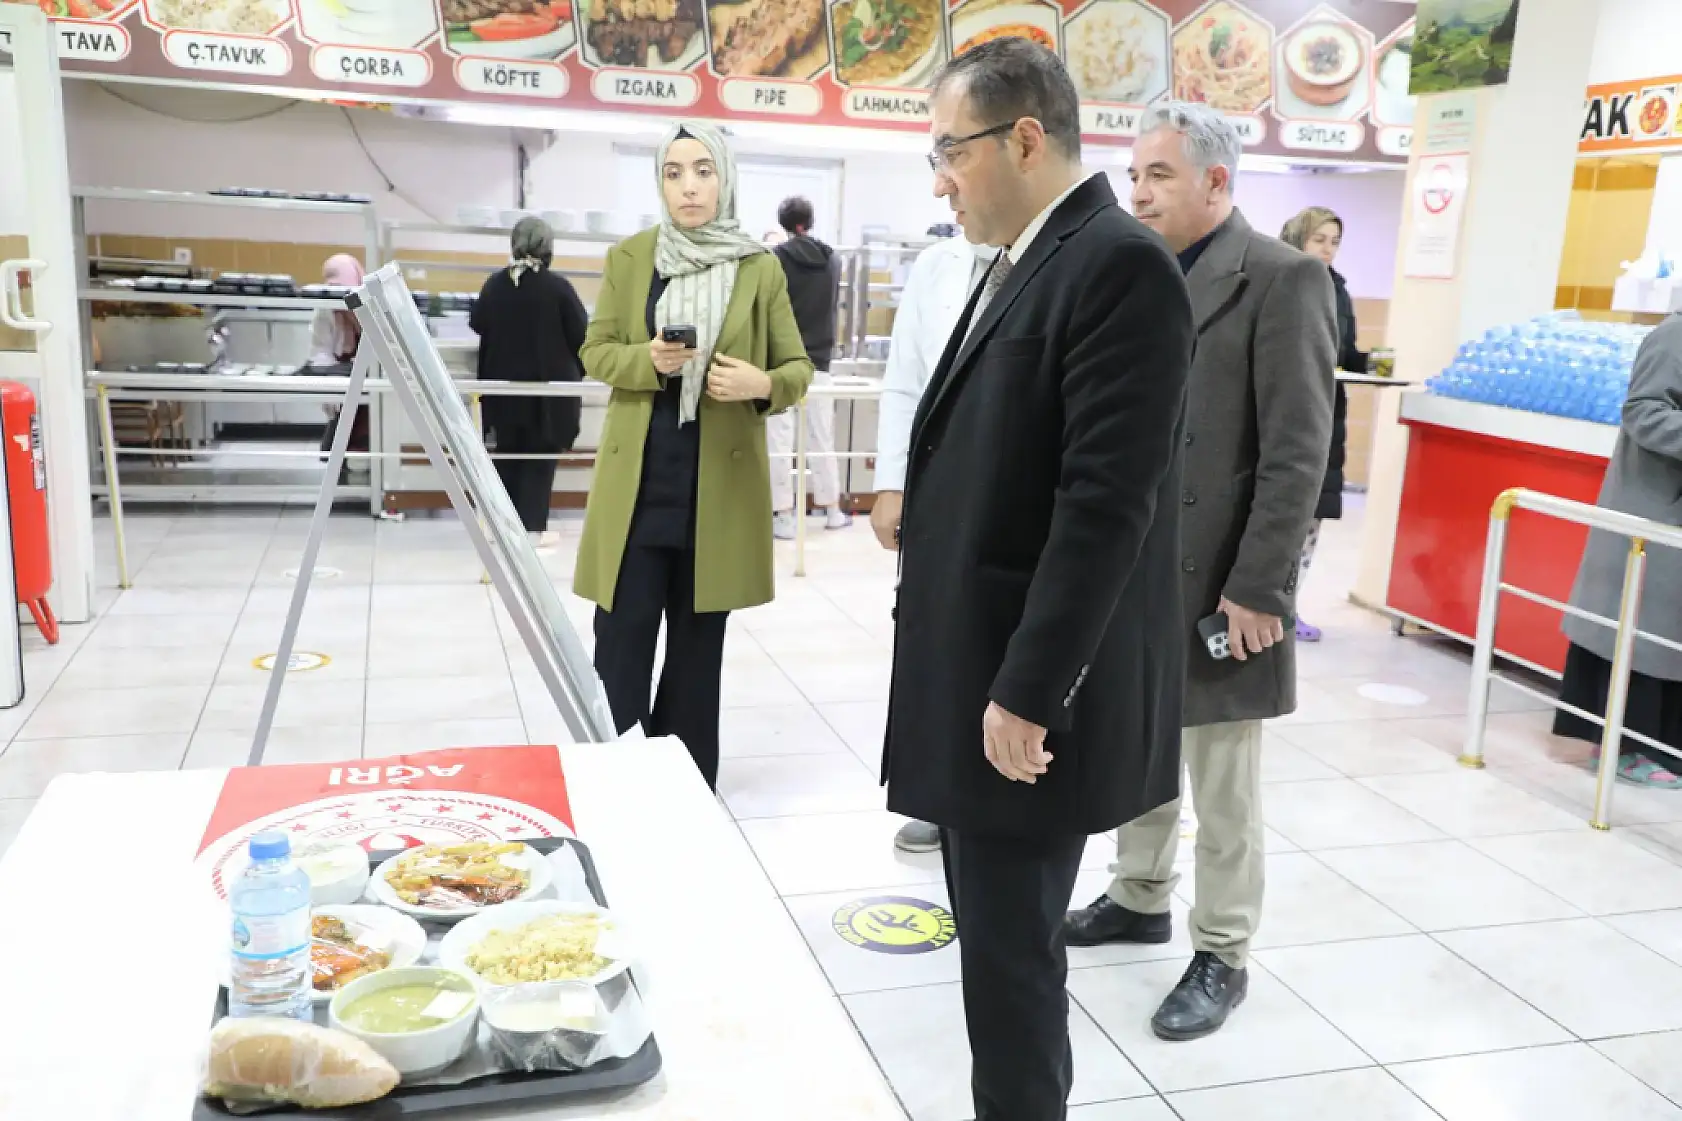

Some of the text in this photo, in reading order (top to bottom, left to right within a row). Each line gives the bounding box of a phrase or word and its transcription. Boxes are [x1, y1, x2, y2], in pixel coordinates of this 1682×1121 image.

[61, 31, 117, 52] TAVA
[187, 41, 267, 65] Ç.TAVUK
[340, 56, 404, 77] ÇORBA
[483, 64, 541, 88] KÖFTE
[615, 79, 677, 98] IZGARA
[852, 95, 929, 115] LAHMACUN
[1580, 94, 1634, 139] AK
[328, 764, 465, 786] AĞRI
